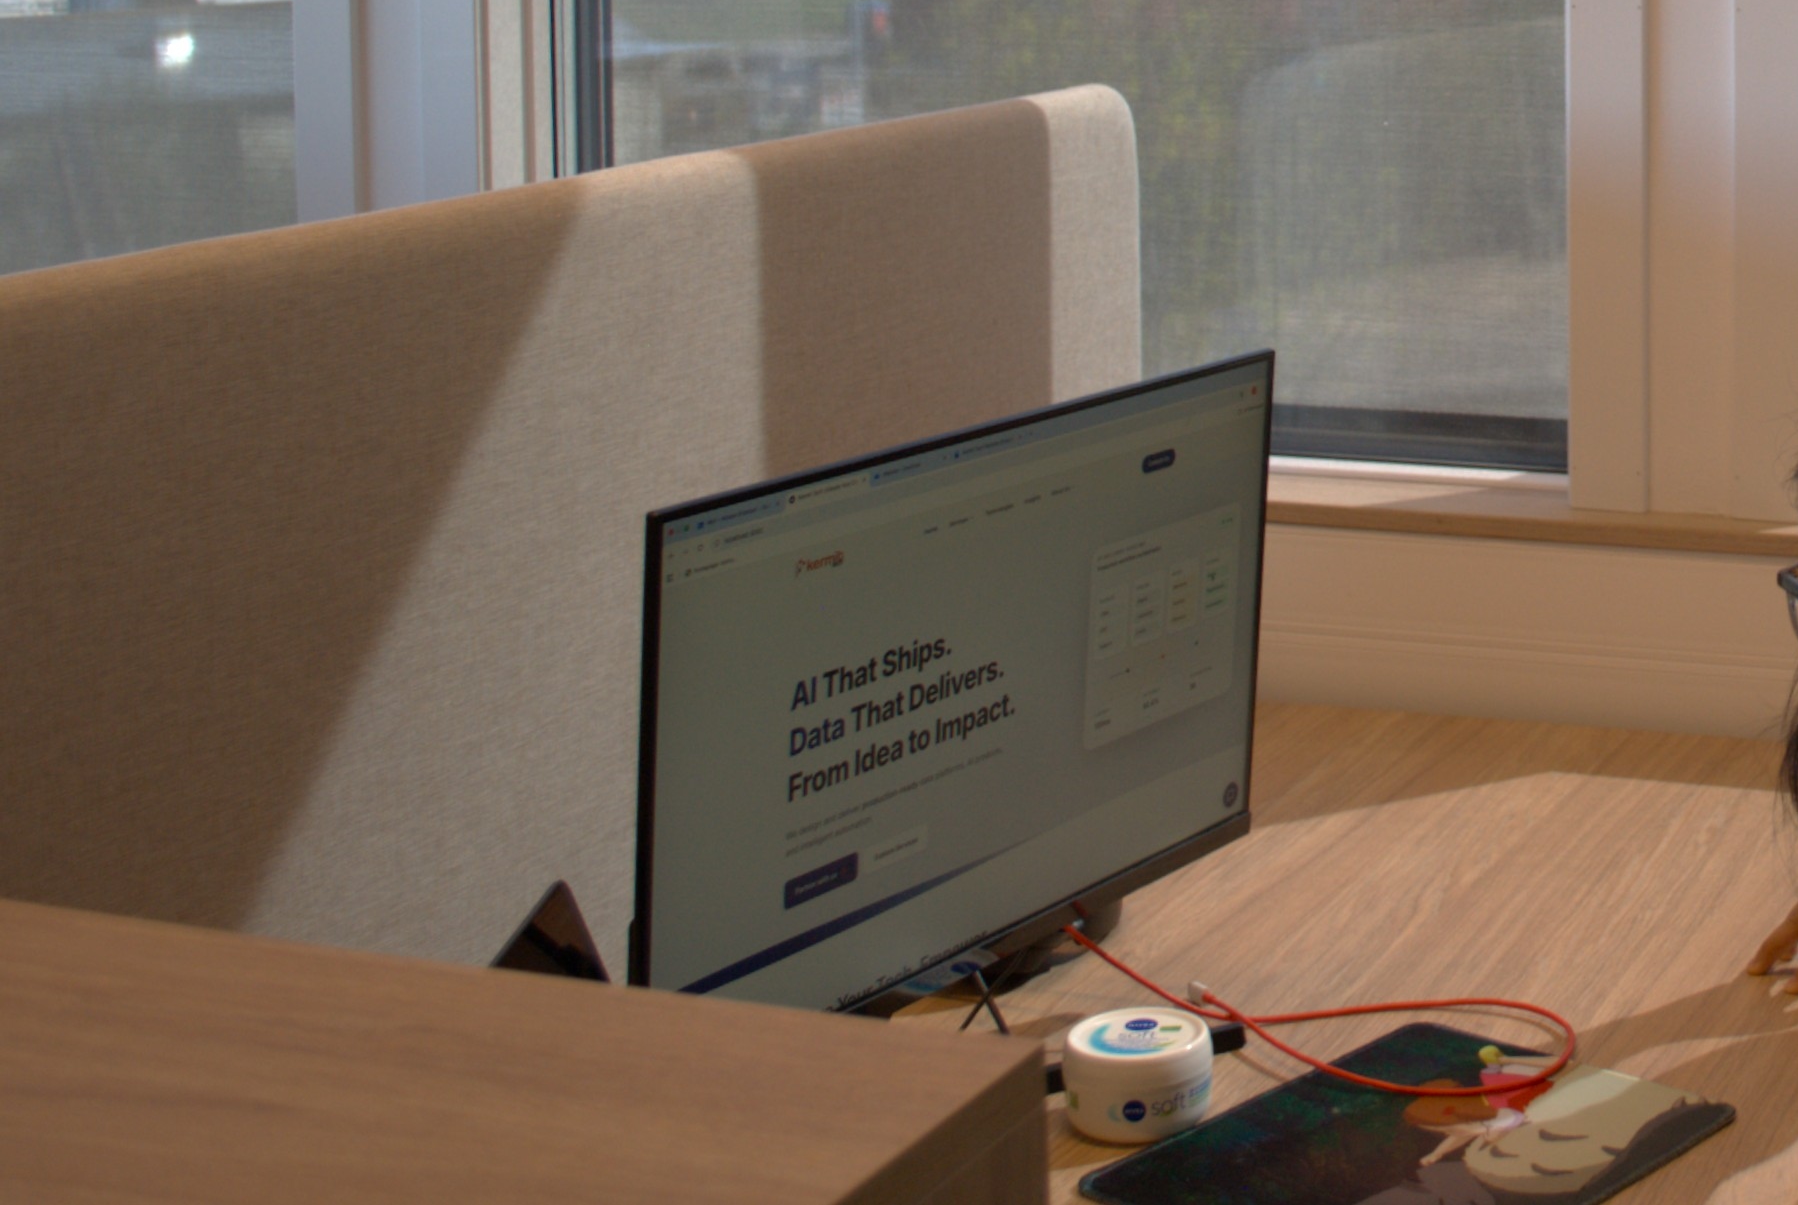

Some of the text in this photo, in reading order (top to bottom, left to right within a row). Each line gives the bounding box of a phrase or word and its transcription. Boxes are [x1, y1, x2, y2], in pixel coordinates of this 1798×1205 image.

[789, 661, 1004, 757] Data That Delivers.
[791, 638, 952, 711] AI That Ships.
[788, 694, 1015, 803] From Idea to Impact.
[1151, 1092, 1186, 1116] soft
